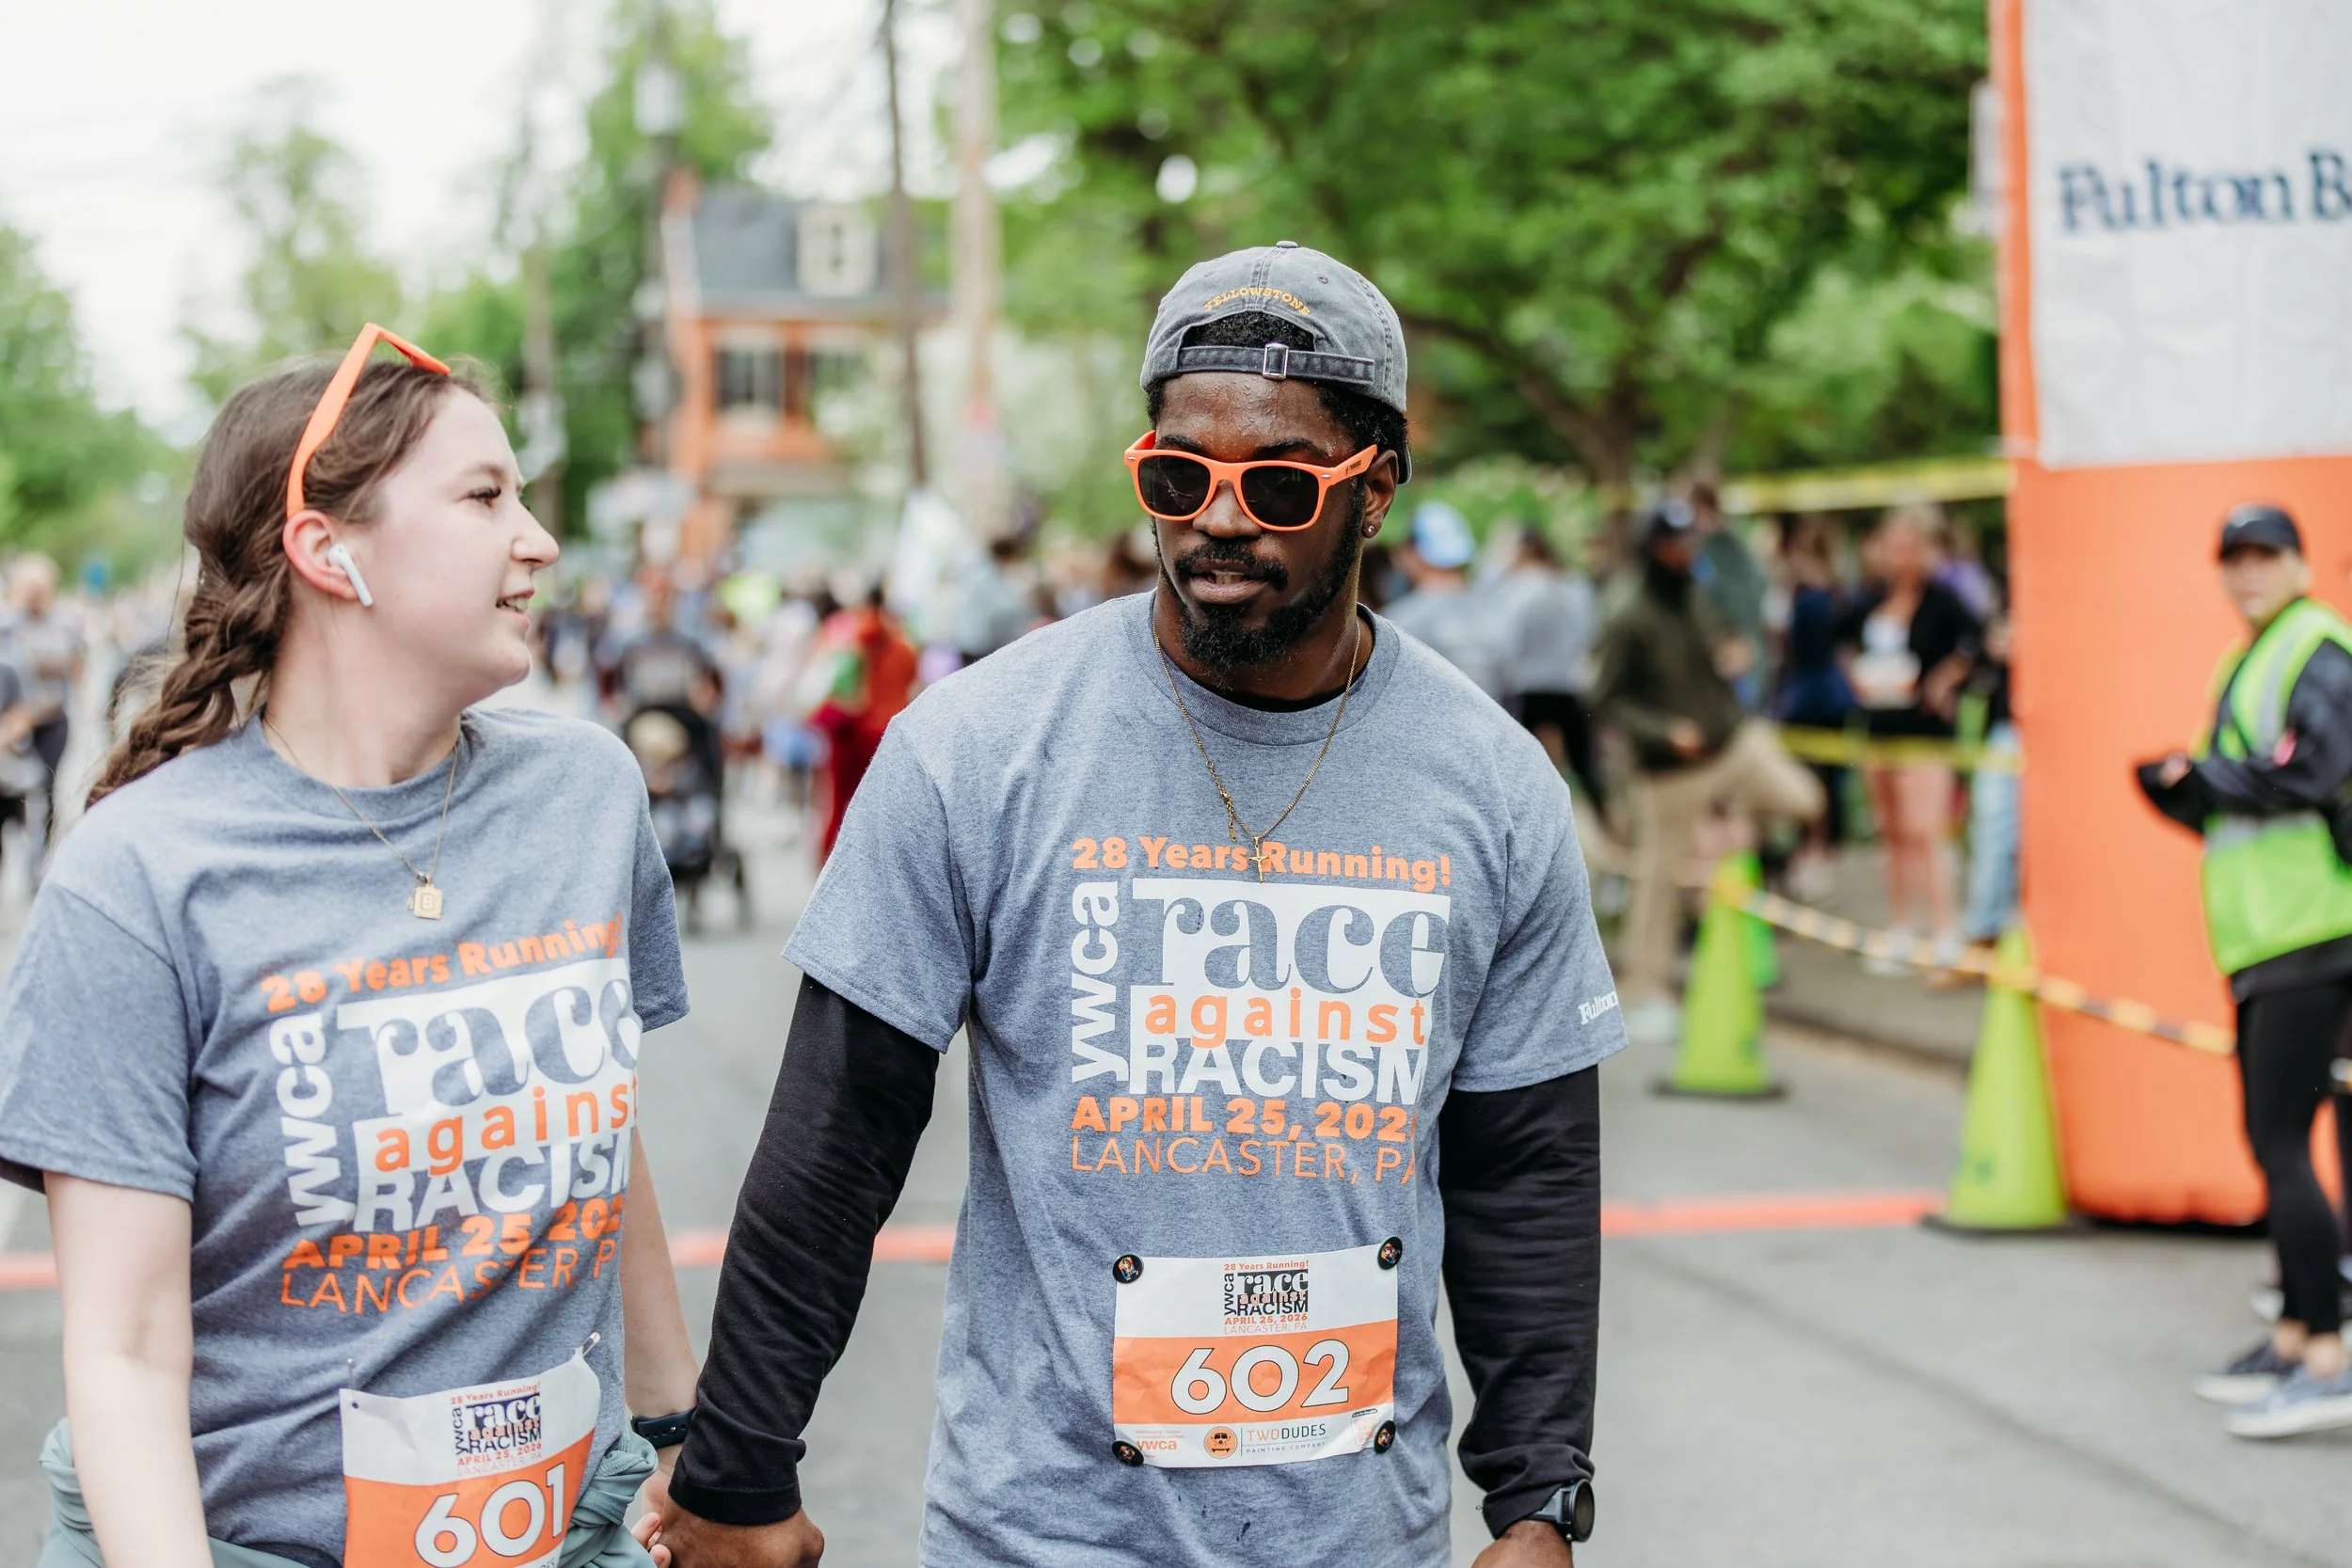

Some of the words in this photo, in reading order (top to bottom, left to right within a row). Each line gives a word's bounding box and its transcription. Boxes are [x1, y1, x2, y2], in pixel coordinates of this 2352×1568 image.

[2058, 161, 2296, 233] Fulton
[1203, 286, 1311, 316] YELLOWSTONE
[1072, 836, 1128, 870] 28
[1138, 835, 1249, 872] Years
[1262, 841, 1452, 893] Running!
[1132, 895, 1450, 999] race
[260, 971, 328, 1014] 28
[332, 954, 451, 993] Years
[1071, 880, 1128, 1084] ywca
[1144, 988, 1426, 1049] against
[1129, 1038, 1427, 1106] RACISM
[269, 1010, 357, 1227] ywca
[374, 1073, 638, 1177] agains
[1071, 1096, 1213, 1132] APRIL
[1227, 1099, 1304, 1142] 25,
[1315, 1102, 1418, 1143] 202
[1072, 1135, 1359, 1185] LANCASTER,
[282, 1224, 449, 1271] APRIL
[1239, 1262, 1263, 1271] Years
[1266, 1259, 1309, 1270] Running!
[1224, 1273, 1237, 1316] ywca
[1236, 1272, 1309, 1294] race
[1239, 1290, 1306, 1306] against
[1224, 1317, 1257, 1325] APRIL
[1259, 1315, 1277, 1324] 25,
[1279, 1313, 1308, 1323] 2026
[1224, 1323, 1291, 1335] LANCASTER,
[1295, 1322, 1307, 1330] PA
[1237, 1299, 1309, 1316] RACISM
[1170, 1338, 1350, 1415] 602
[453, 1407, 469, 1455] ywca
[467, 1395, 540, 1428] race
[457, 1453, 492, 1466] APRIL
[469, 1427, 542, 1454] RACISM
[1246, 1445, 1286, 1453] PAINTING
[1290, 1442, 1326, 1450] COMPANY
[413, 1461, 564, 1568] 601
